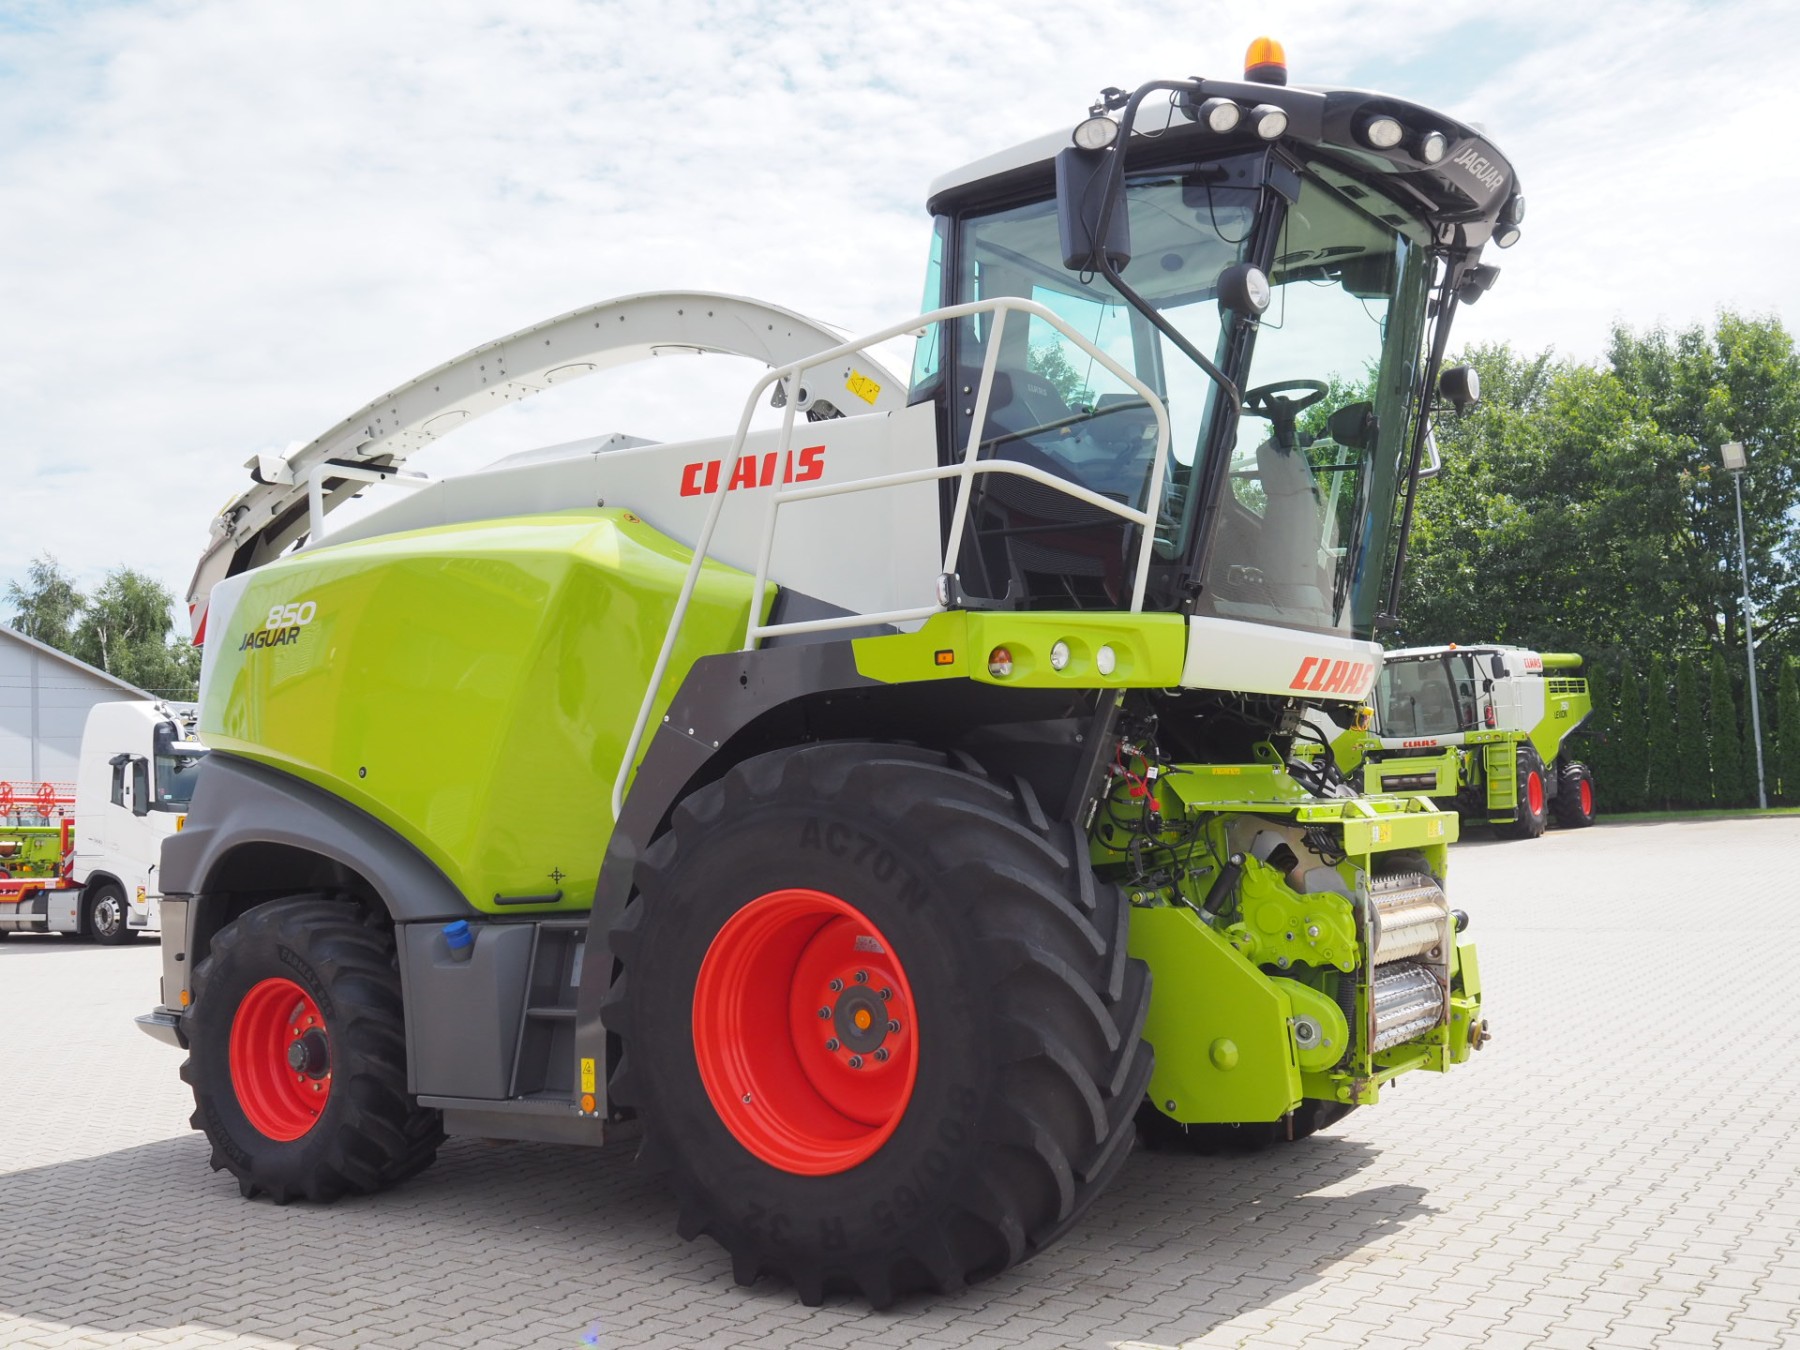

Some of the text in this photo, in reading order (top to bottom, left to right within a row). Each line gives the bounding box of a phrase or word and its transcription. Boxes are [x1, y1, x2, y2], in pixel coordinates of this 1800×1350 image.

[1453, 148, 1504, 192] JAGUAR
[266, 601, 317, 629] 850
[238, 626, 301, 651] JAGUAR
[1288, 656, 1375, 694] CLAAS
[1524, 658, 1541, 669] CLAAS
[1402, 740, 1437, 748] CLAAS
[800, 817, 897, 884] AC70
